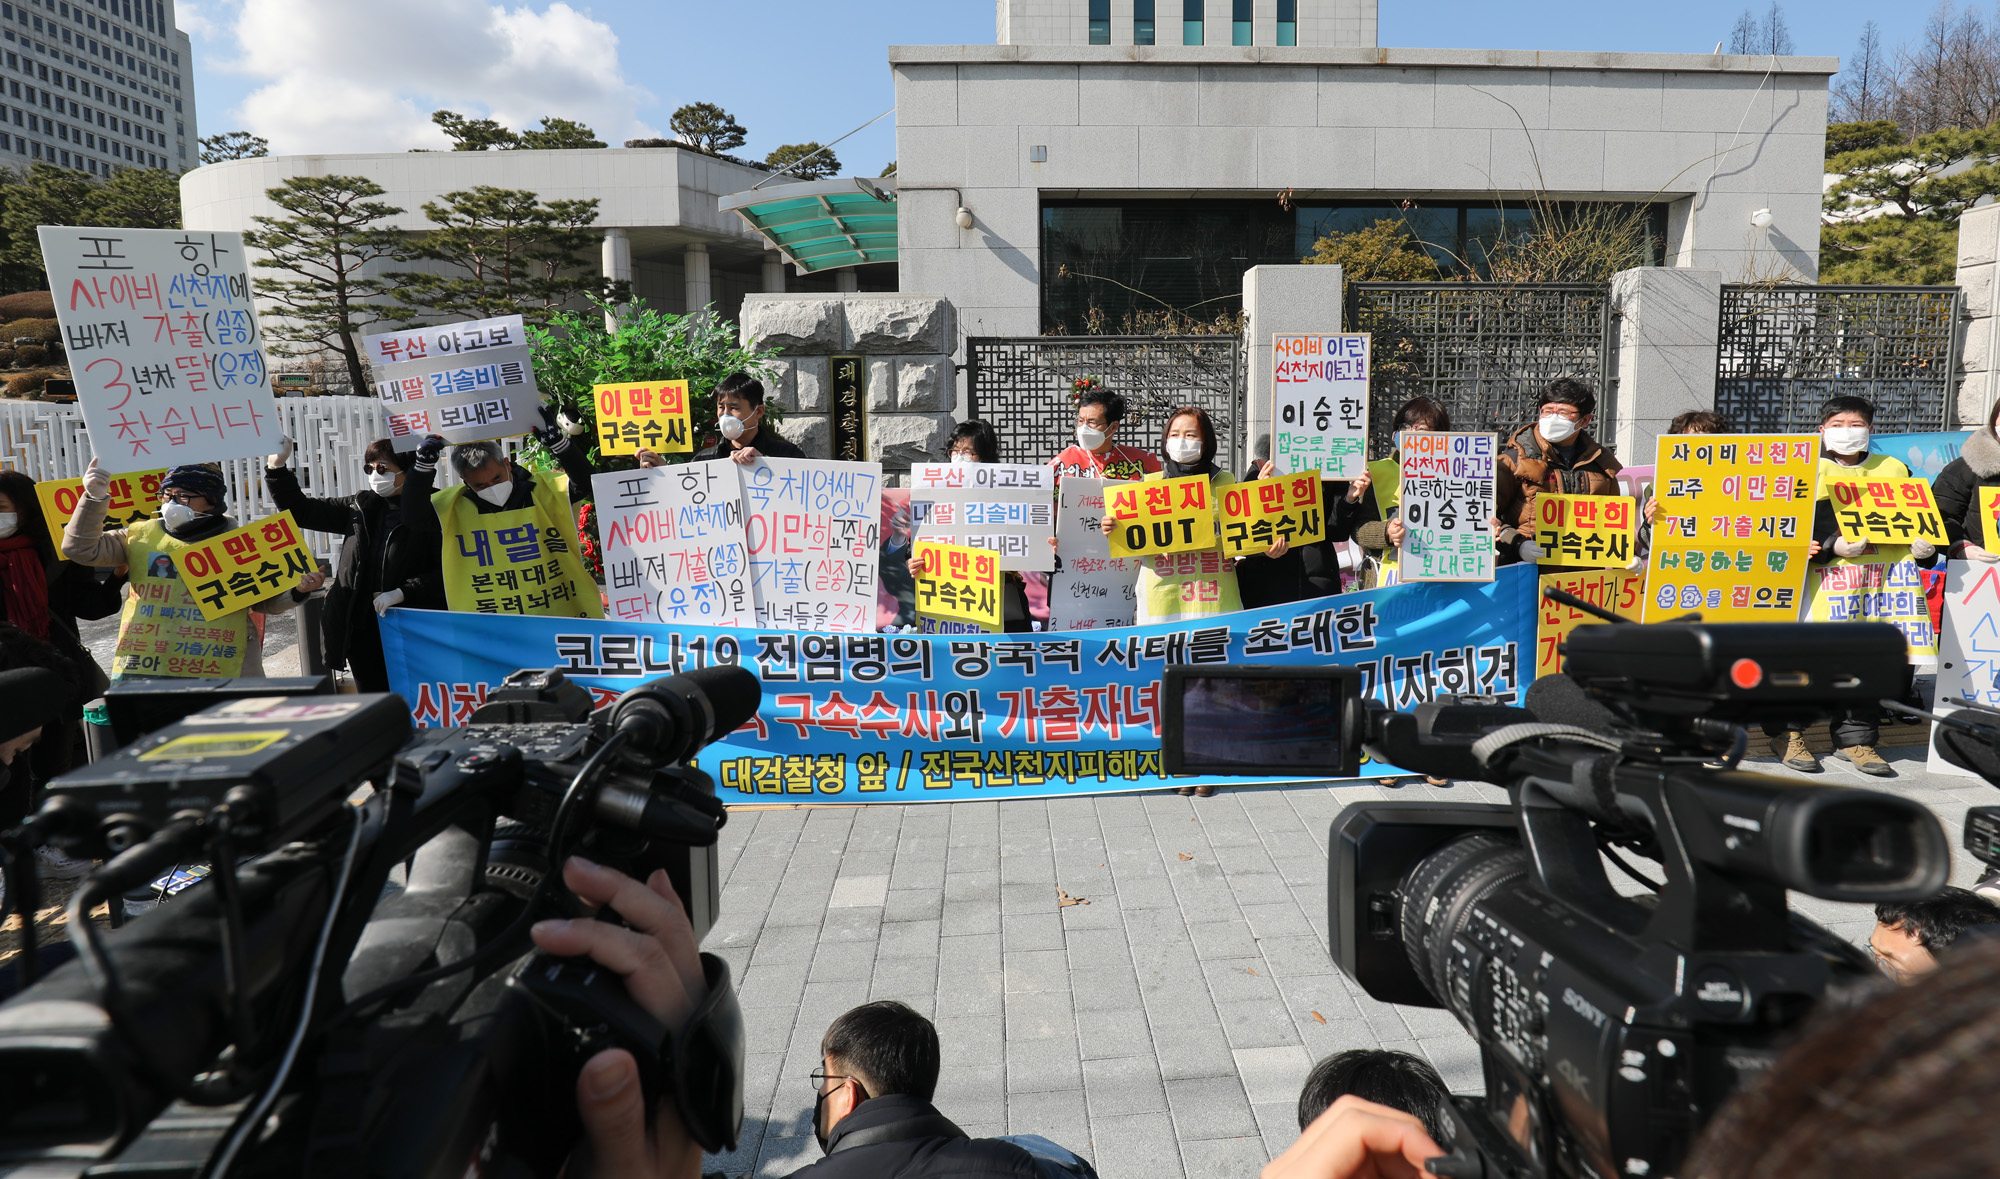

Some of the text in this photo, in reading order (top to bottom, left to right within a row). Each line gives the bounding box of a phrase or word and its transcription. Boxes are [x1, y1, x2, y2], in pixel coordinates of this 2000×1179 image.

[70, 272, 250, 311] 사이비 신천지에
[67, 309, 256, 351] 빠져 가출(실종)
[380, 325, 514, 362] 부산 야고보
[1275, 335, 1366, 358] 사이비 이단
[430, 361, 525, 396] 김솔비를
[1275, 358, 1368, 383] 신천지 야고보
[600, 386, 684, 417] 이만희
[1282, 396, 1364, 432] 이승환
[109, 399, 264, 457] 찾습니다
[388, 398, 511, 438] 돌려 보내라
[602, 417, 687, 449] 구속수사
[1278, 431, 1366, 457] 집으로 돌려
[1404, 435, 1491, 460] 사이비 이단
[1671, 442, 1812, 466] 사이비 신천지
[922, 467, 1042, 489] 부산 야고보
[1100, 459, 1145, 480] 신천지
[1289, 453, 1346, 477] 보내라
[1403, 457, 1494, 483] 신천지 야고보
[1112, 481, 1206, 520] 신천지
[1224, 477, 1317, 518] 이만희
[1666, 477, 1704, 500] 교주
[1721, 475, 1809, 502] 이만희는
[1834, 481, 1931, 509] 이만희
[606, 498, 744, 551] 사이비 신천지에
[964, 502, 1051, 526] 김솔비를
[1226, 508, 1320, 551] 구속수사
[1408, 498, 1492, 532] 이승환
[1542, 498, 1629, 530] 이만희
[1666, 515, 1697, 538] 7년
[1840, 511, 1941, 538] 구속수사
[184, 518, 297, 579] 이만희
[1126, 518, 1195, 550] OUT
[1459, 532, 1494, 555] 돌려
[1540, 530, 1630, 562] 구속수사
[612, 542, 747, 589] 빠져 가출(실종)
[919, 547, 995, 586] 이만희
[1418, 553, 1486, 577] 보내라
[1659, 550, 1789, 574] 사랑하는 딸
[196, 547, 312, 611] 구속수사
[1181, 579, 1219, 602] 3년
[919, 578, 997, 617] 구속수사
[1656, 583, 1794, 609] 은화를 집으로
[554, 602, 1378, 682] 코로나19 전염병의 망국적 사태를 초래한
[167, 657, 222, 675] 양성소
[776, 689, 986, 743] 구속수사와
[1356, 643, 1517, 715] 기자회견
[721, 751, 849, 794] 대검찰청
[858, 747, 893, 793] 앞
[921, 746, 1200, 789] 전국신천지피해자
[1562, 986, 1608, 1029] SONY
